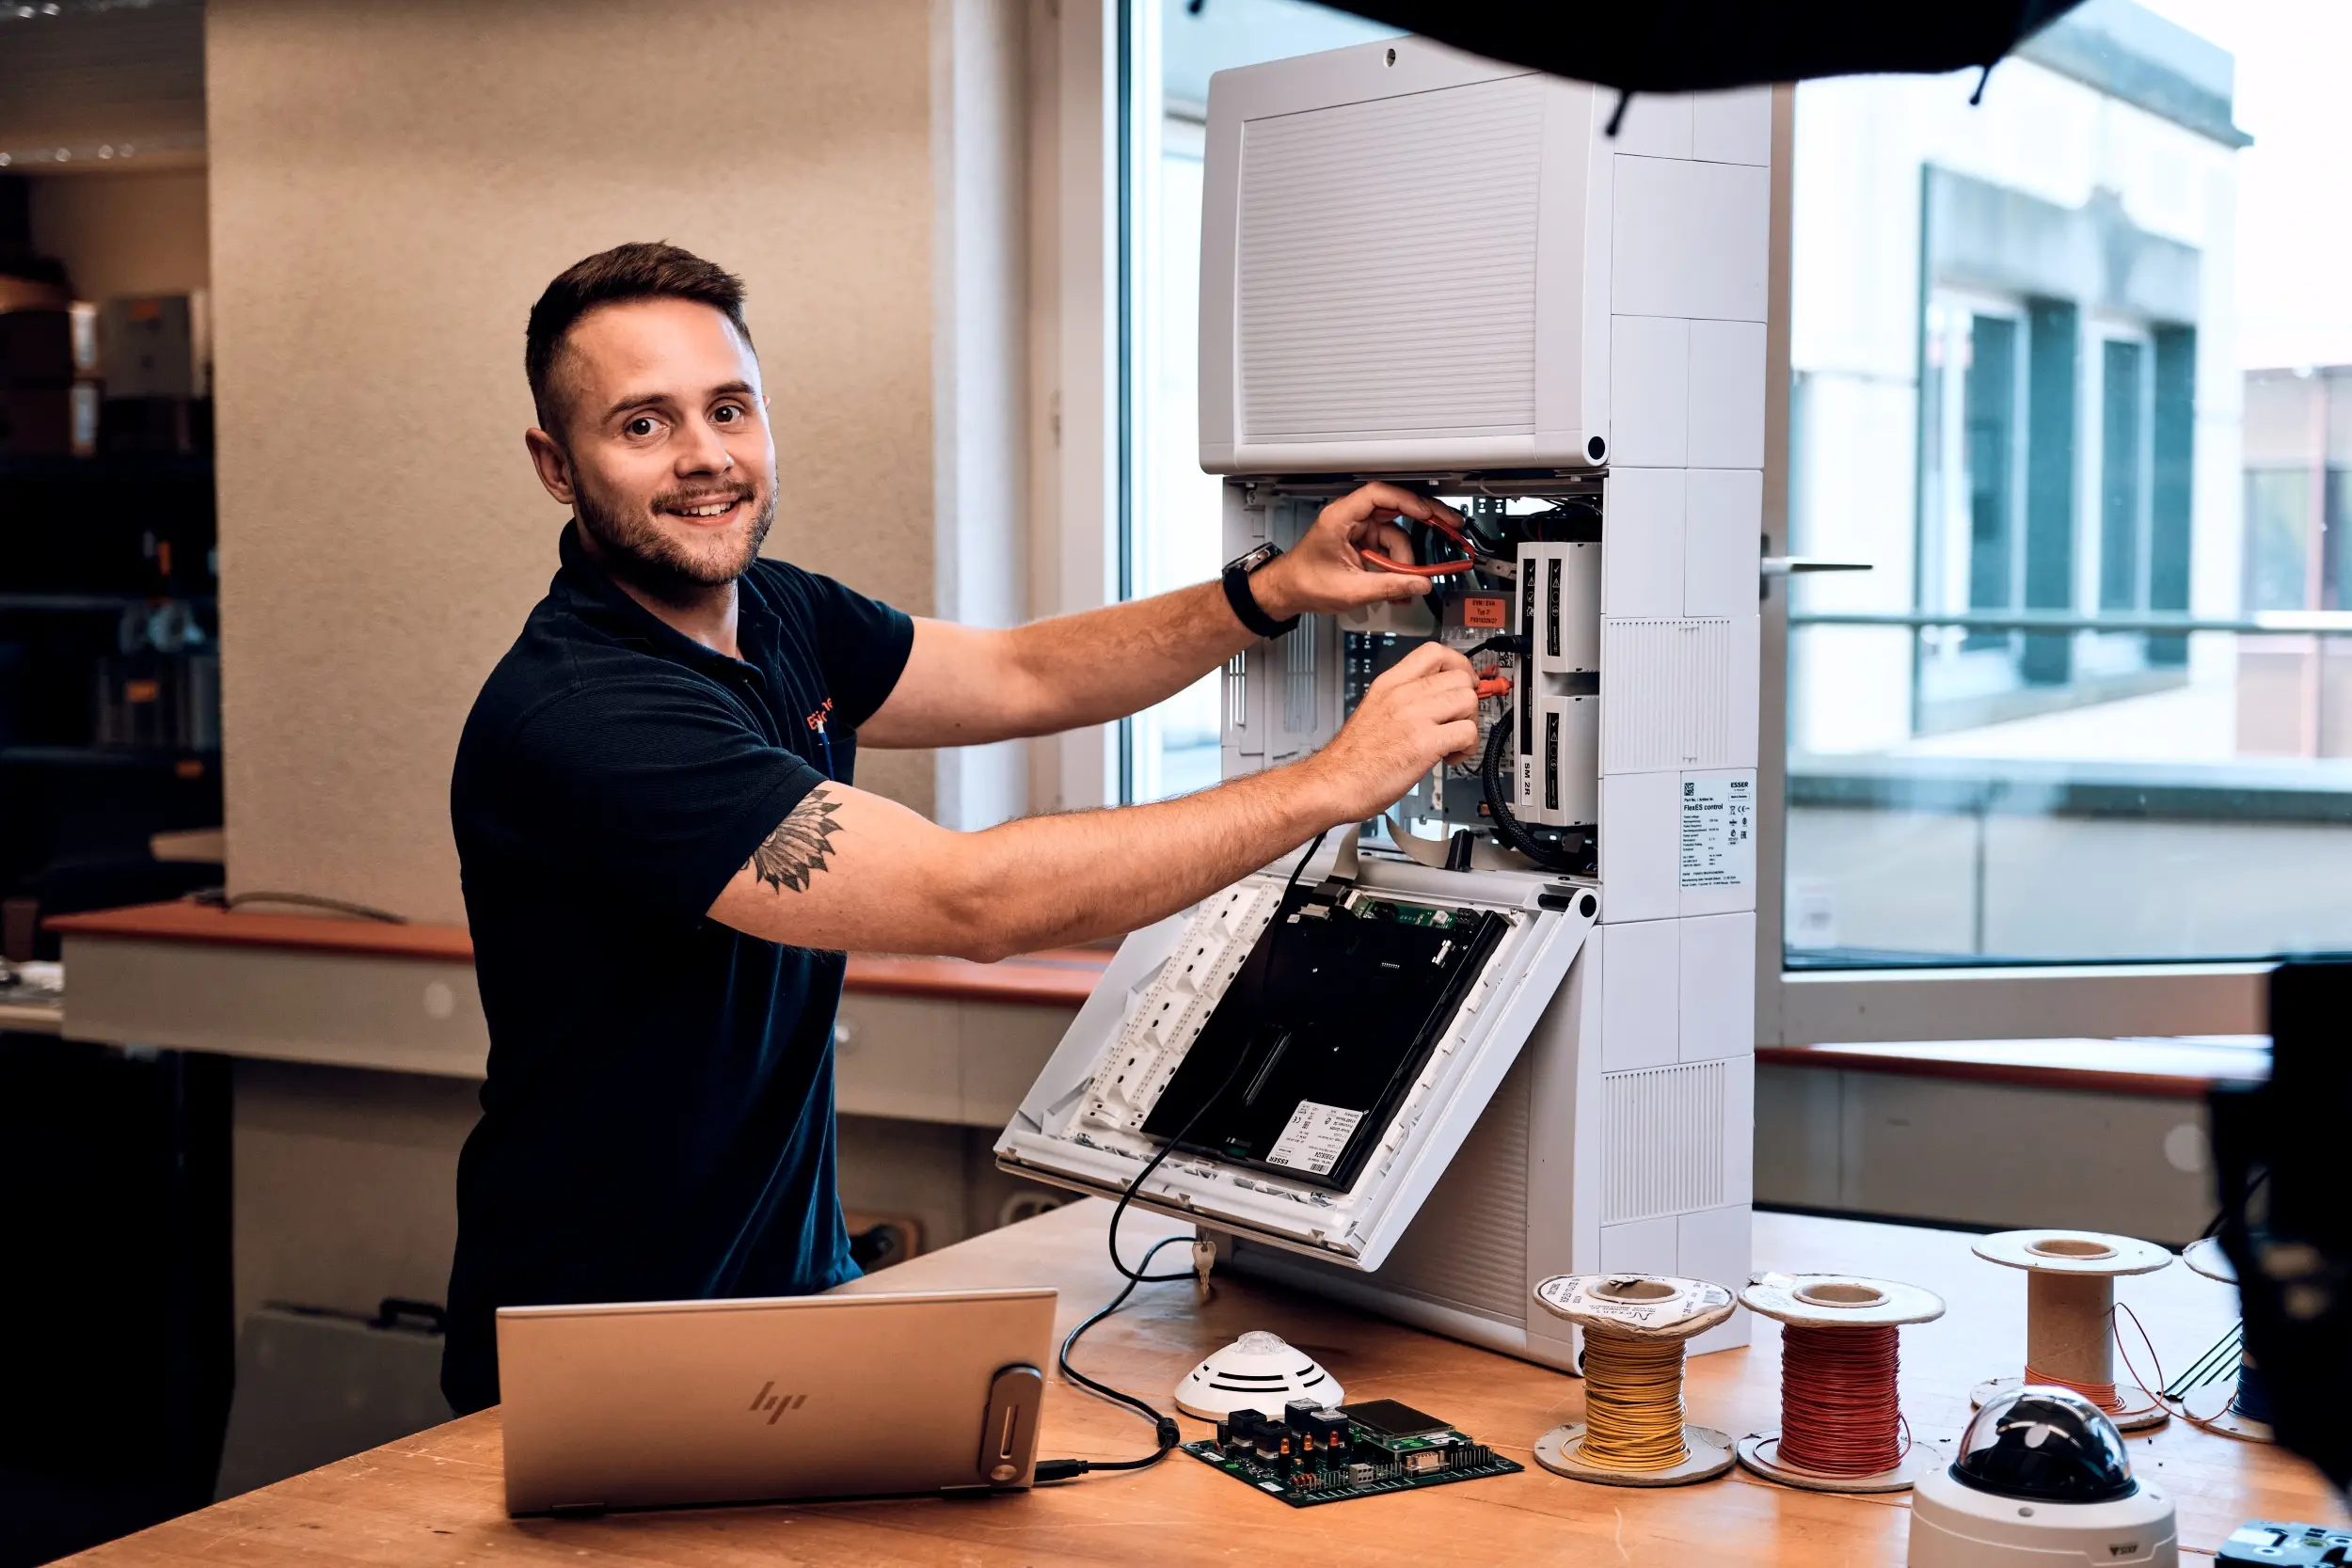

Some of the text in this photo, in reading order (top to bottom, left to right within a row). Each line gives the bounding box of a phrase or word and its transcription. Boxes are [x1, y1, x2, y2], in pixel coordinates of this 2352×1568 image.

[1524, 762, 1531, 796] SM 2R
[1269, 1156, 1289, 1164] ESSER
[750, 1382, 807, 1424] hp
